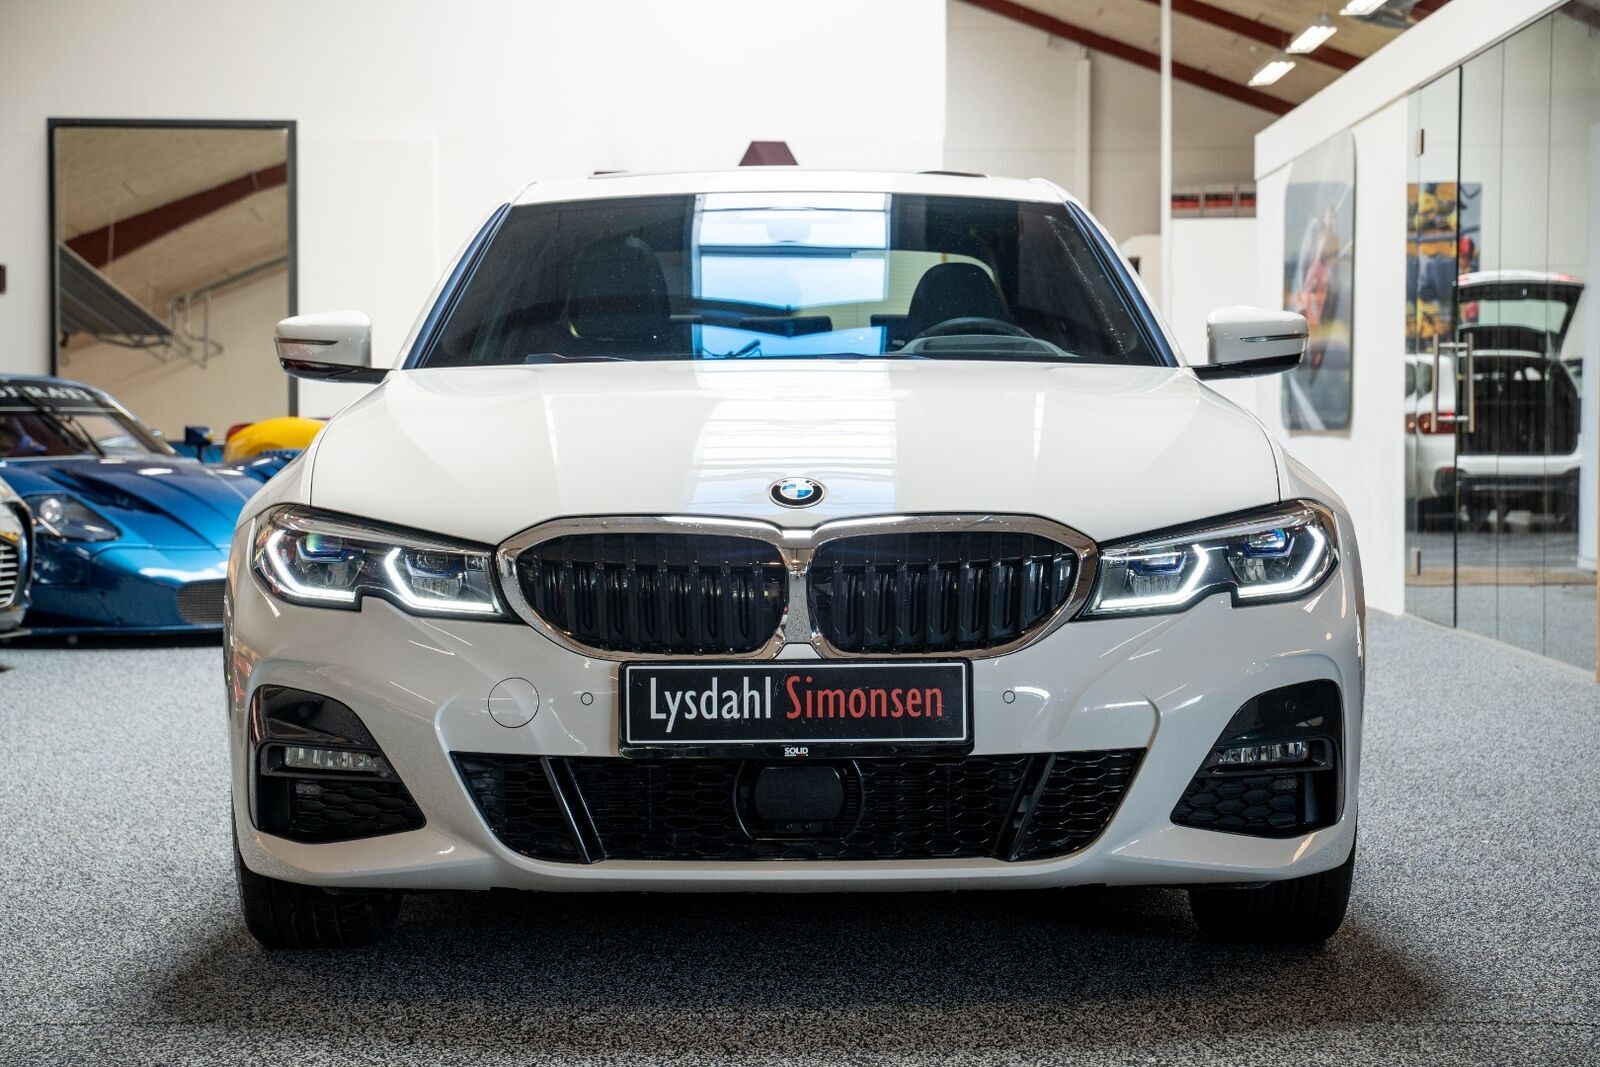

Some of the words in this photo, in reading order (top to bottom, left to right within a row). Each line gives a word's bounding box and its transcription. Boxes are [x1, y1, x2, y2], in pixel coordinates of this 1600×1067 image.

[650, 676, 771, 733] Lysdahl
[786, 675, 943, 719] Simonsen
[784, 747, 809, 755] SOLID
